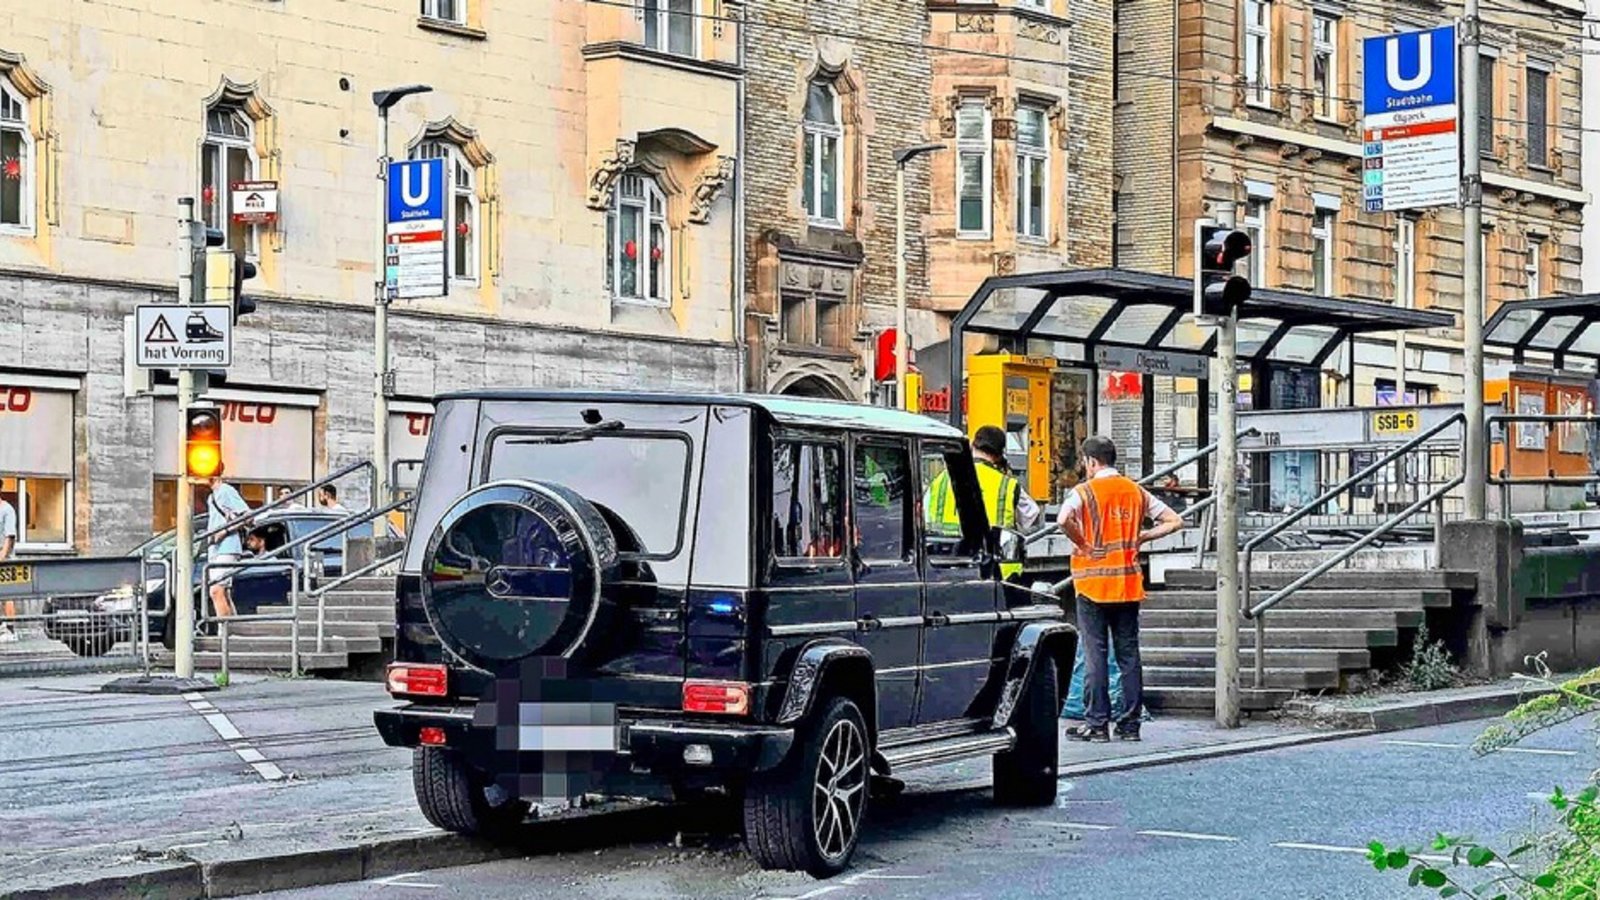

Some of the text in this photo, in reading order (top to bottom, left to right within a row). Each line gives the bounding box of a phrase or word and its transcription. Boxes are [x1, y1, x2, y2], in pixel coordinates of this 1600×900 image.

[1386, 31, 1432, 92] U
[1386, 94, 1433, 109] Stadtbahn
[402, 162, 430, 207] U
[145, 346, 224, 362] hat Vorrang
[1378, 414, 1414, 430] SSB-G
